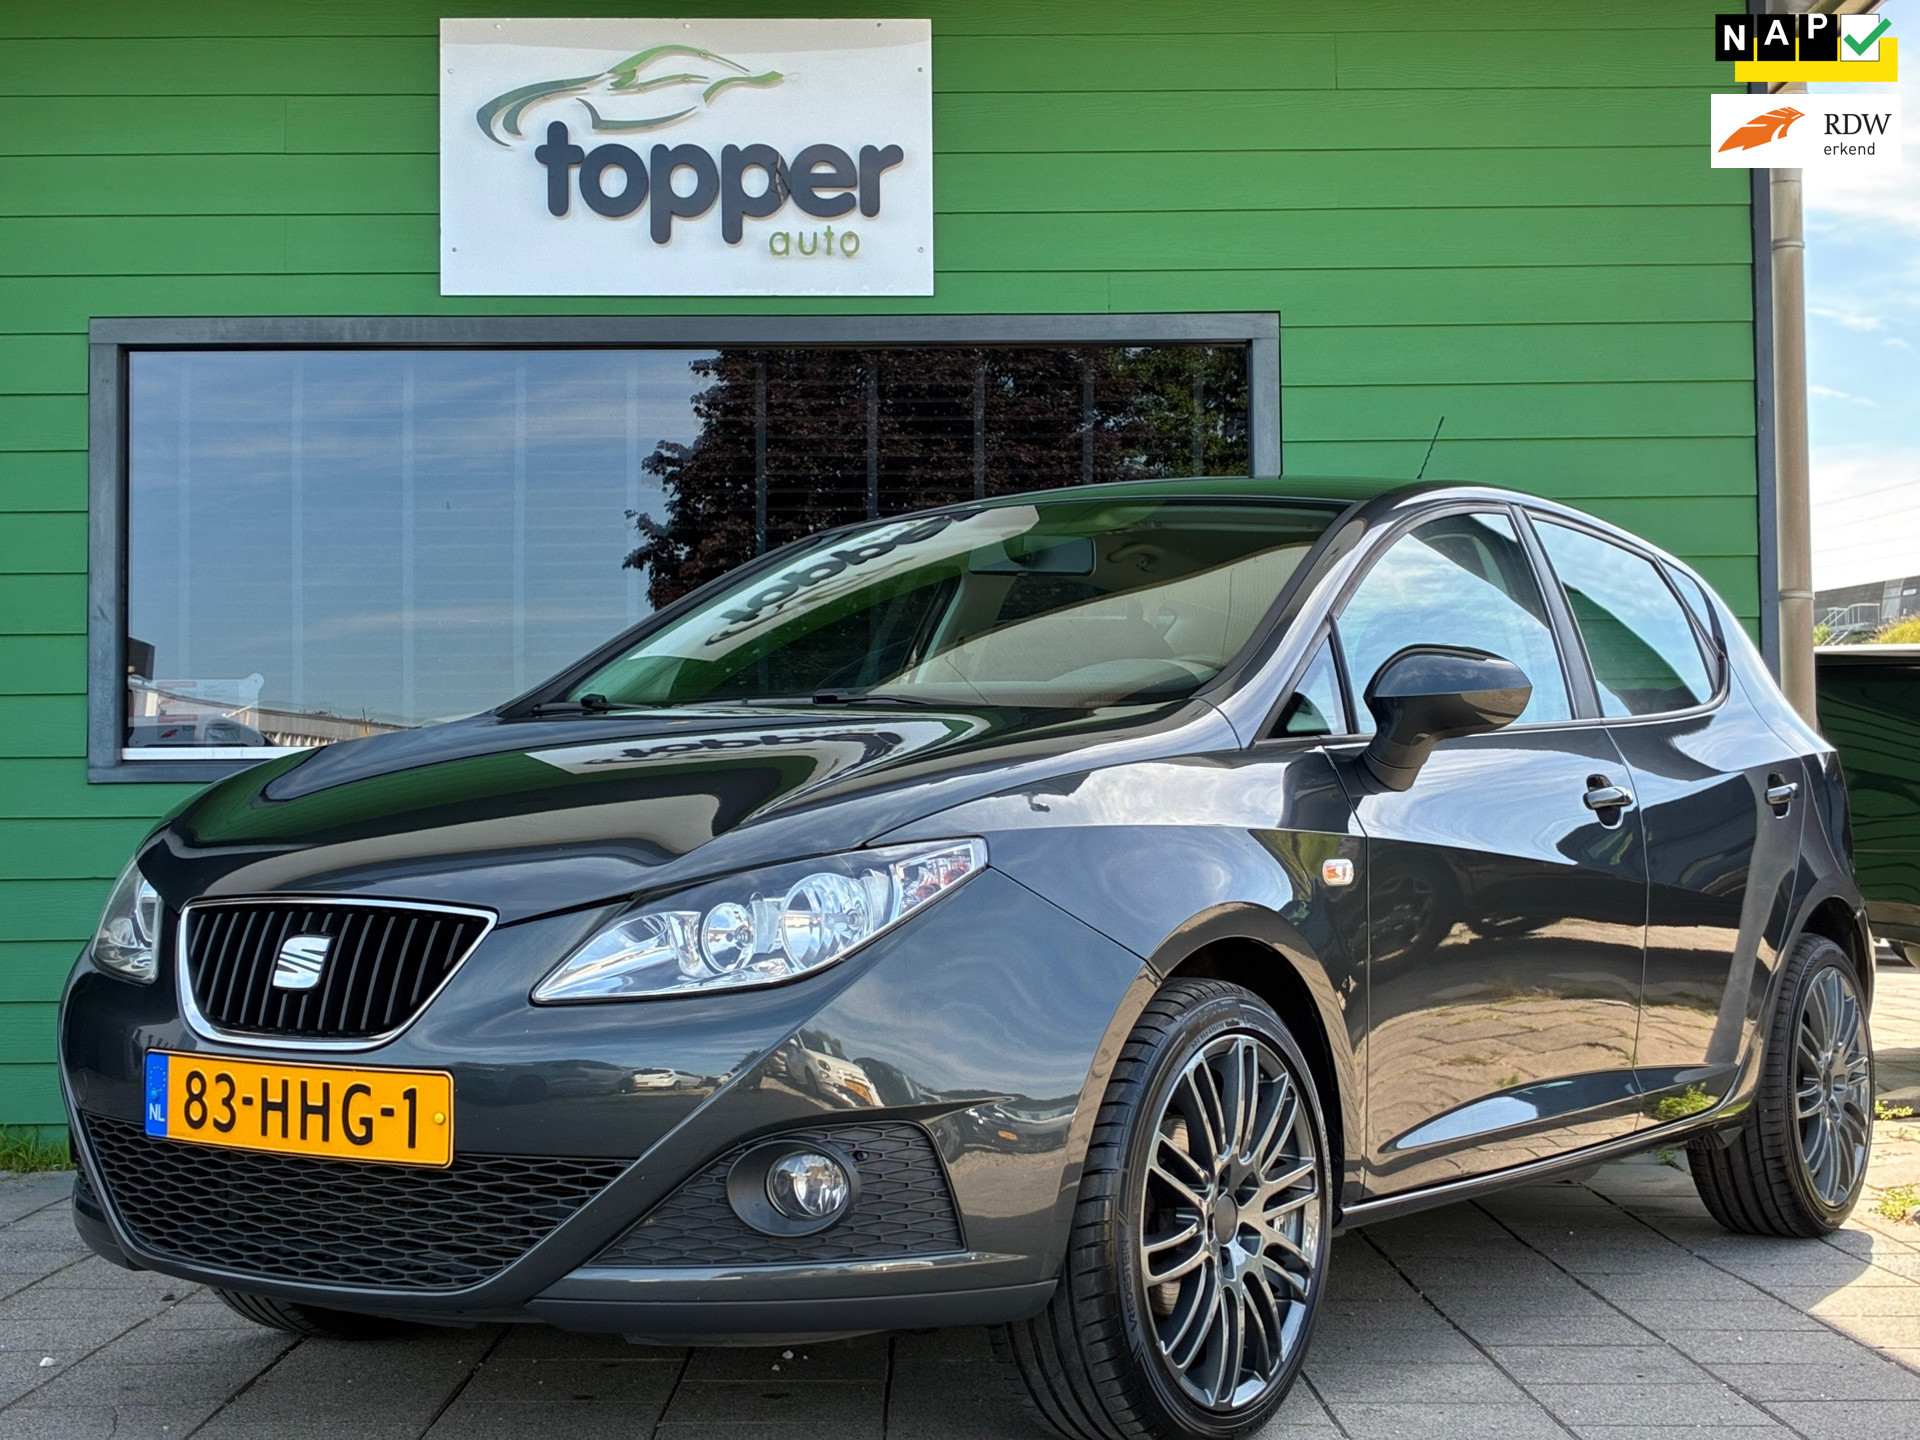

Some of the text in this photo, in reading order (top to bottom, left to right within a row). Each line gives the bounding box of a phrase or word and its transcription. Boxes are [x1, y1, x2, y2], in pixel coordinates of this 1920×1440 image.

[534, 120, 904, 245] topper
[768, 225, 861, 257] auto
[149, 1102, 166, 1122] NL
[184, 1070, 418, 1149] 83-HHG-1
